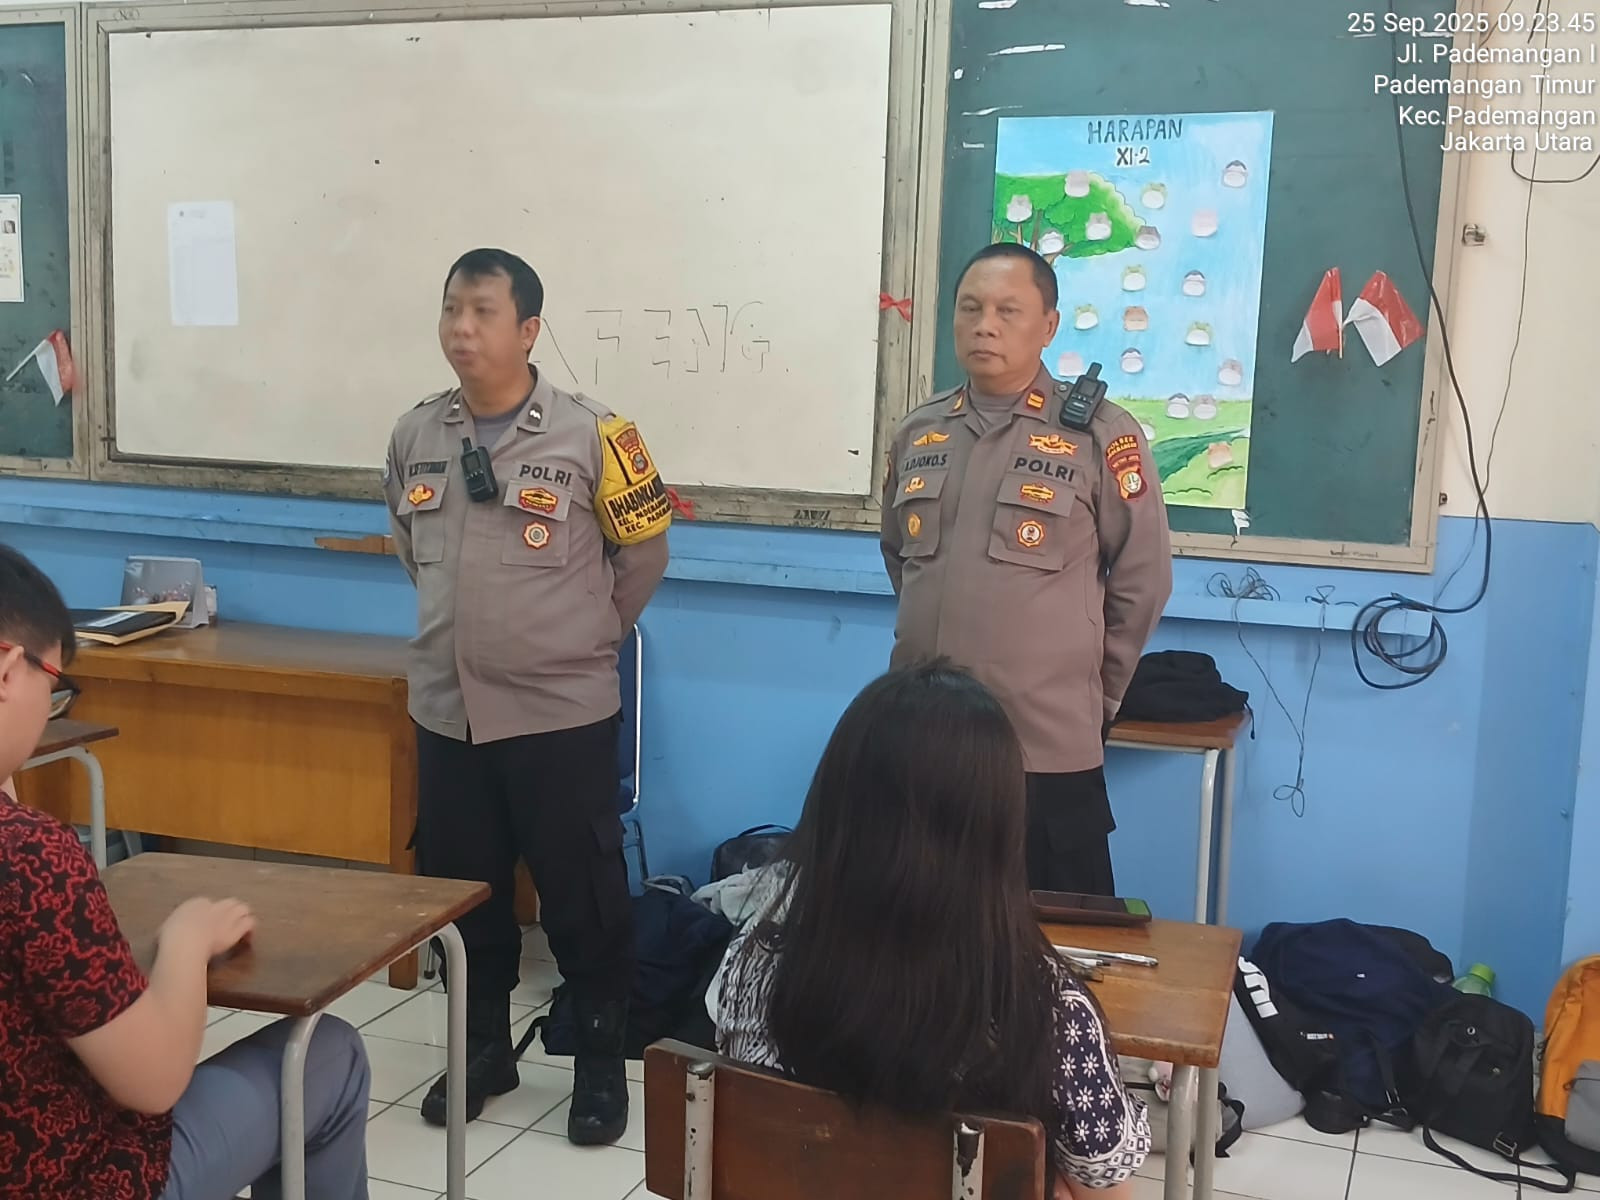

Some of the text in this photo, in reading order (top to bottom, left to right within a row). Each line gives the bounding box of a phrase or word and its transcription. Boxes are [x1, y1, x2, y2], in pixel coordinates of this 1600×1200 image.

[1088, 118, 1183, 144] HARAPAN
[519, 464, 572, 487] POLRI
[1013, 457, 1075, 482] POLRI
